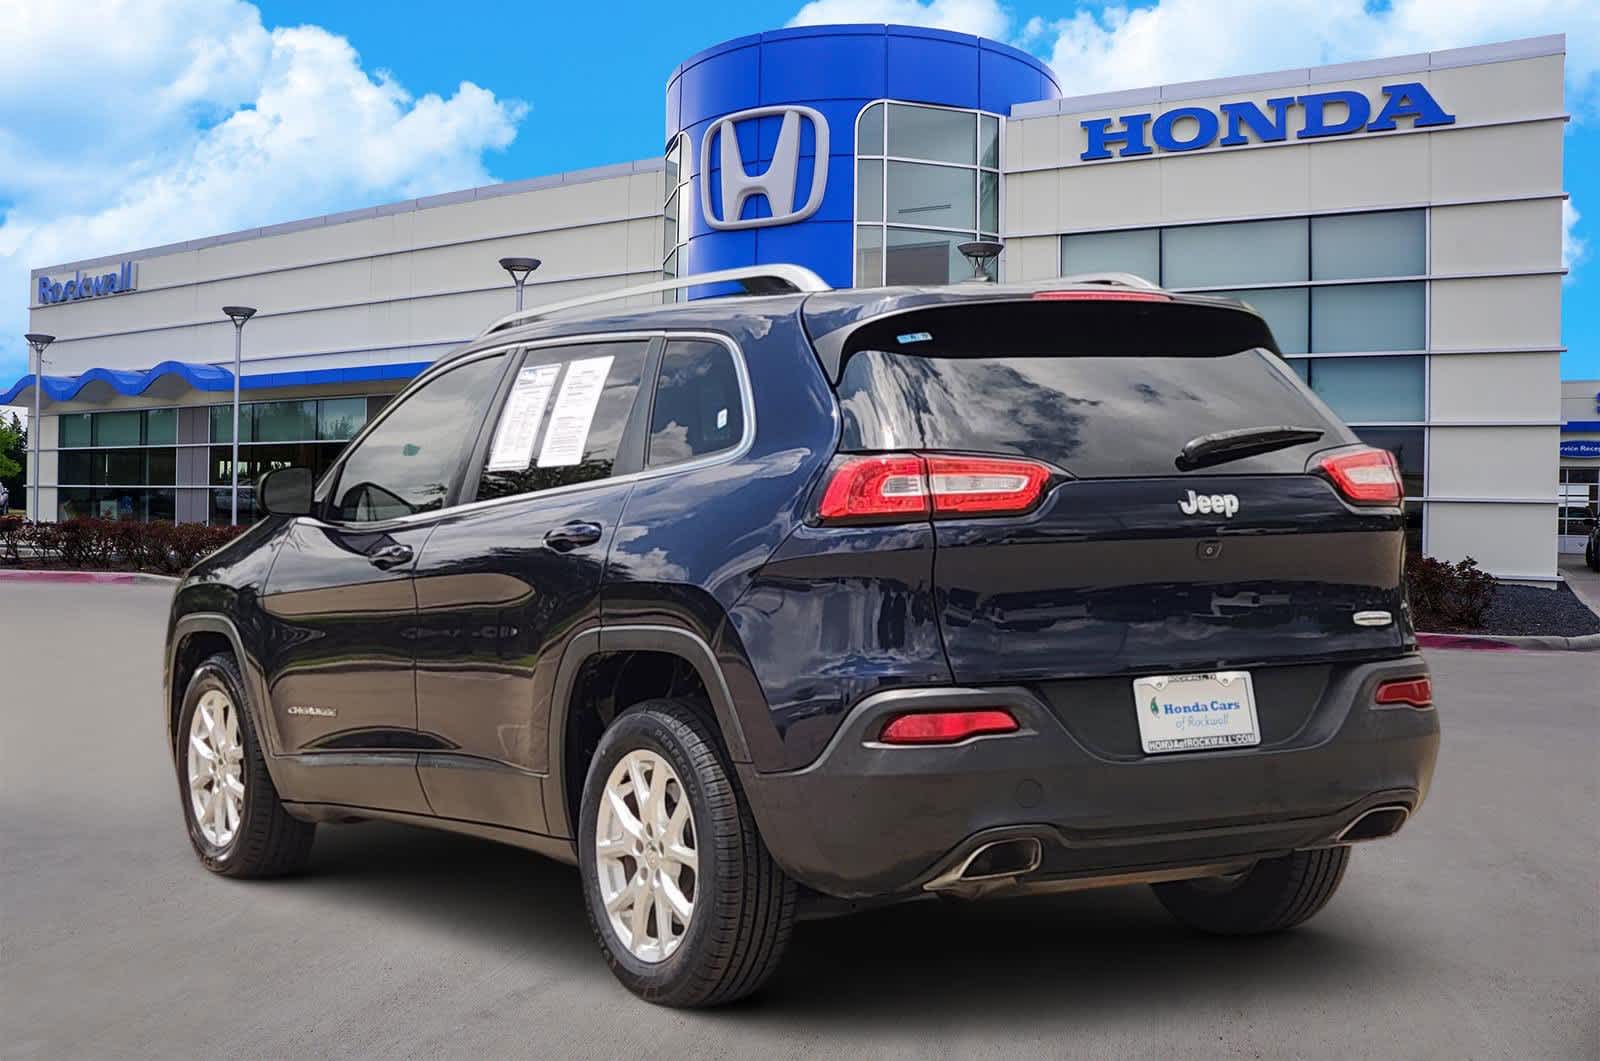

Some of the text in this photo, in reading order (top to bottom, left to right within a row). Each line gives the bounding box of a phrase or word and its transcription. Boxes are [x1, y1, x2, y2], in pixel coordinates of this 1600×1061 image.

[1080, 82, 1455, 161] HONDA
[1178, 488, 1239, 518] Jeep
[1163, 700, 1241, 715] Honda Cars
